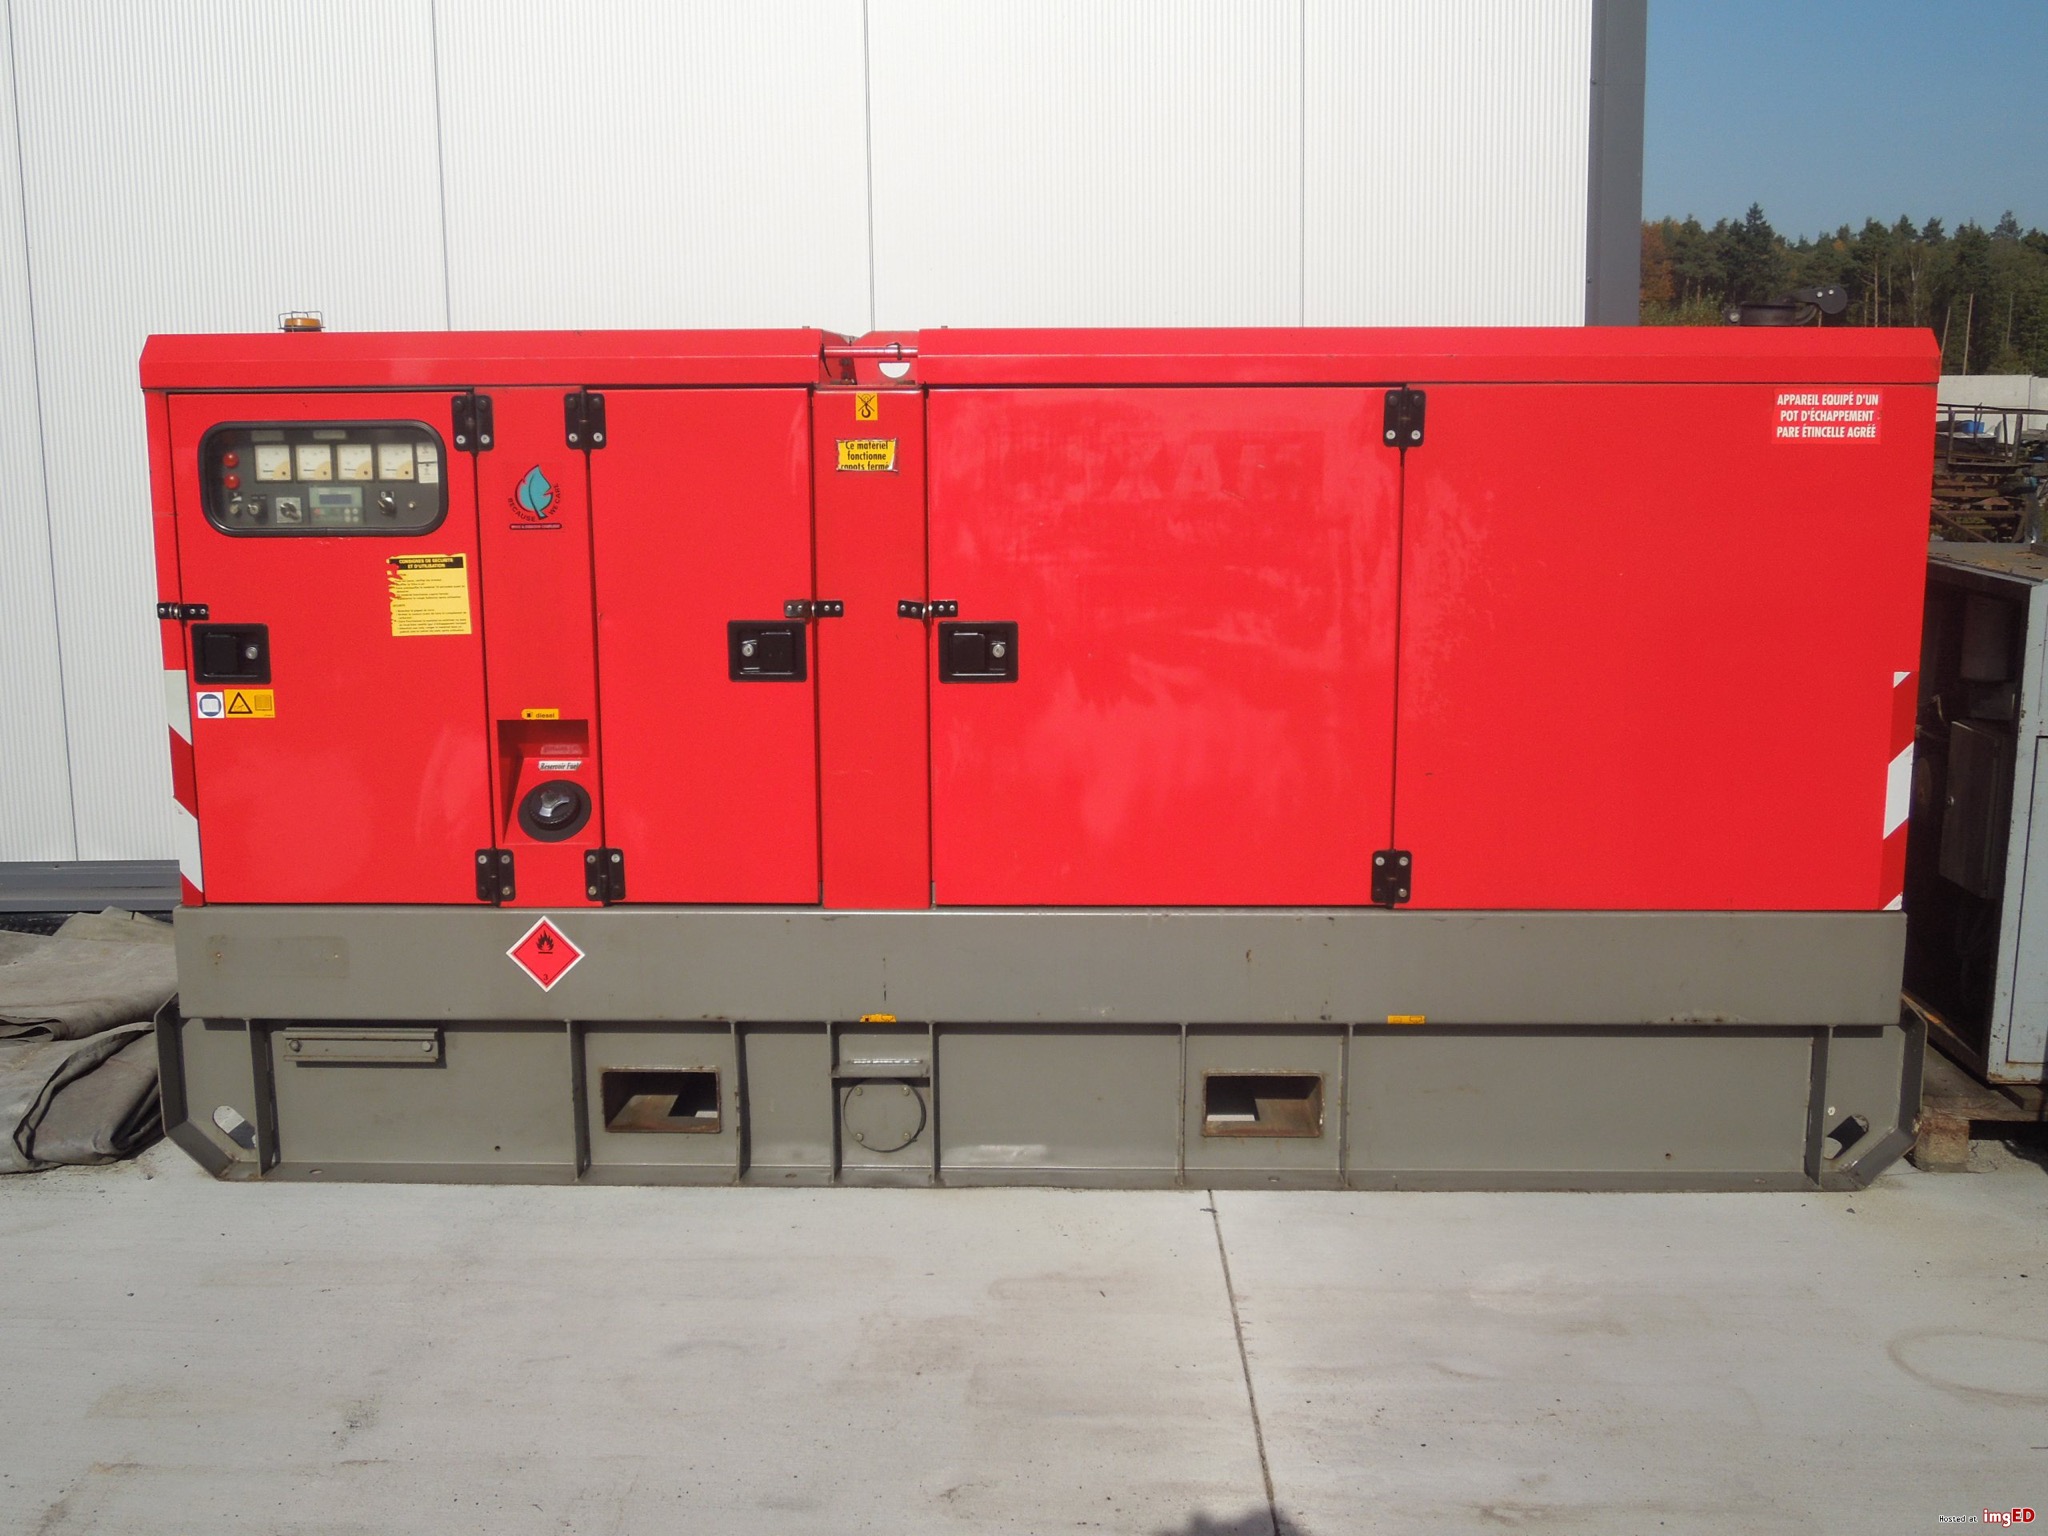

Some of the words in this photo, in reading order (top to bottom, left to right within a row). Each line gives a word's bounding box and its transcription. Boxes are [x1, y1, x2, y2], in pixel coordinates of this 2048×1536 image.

[1777, 394, 1820, 406] APPAREIL
[1821, 391, 1854, 406] EQUIPÉ
[1856, 394, 1879, 406] D'UN
[1780, 410, 1799, 422] POT
[1801, 407, 1875, 422] D'ÉCHAPPEMENT
[1776, 426, 1800, 438] PARE
[1802, 423, 1845, 438] ÉTINCELLE
[1847, 423, 1877, 438] AGRÉÉ
[845, 441, 855, 450] Ce
[847, 450, 886, 461] fonctionne
[867, 460, 891, 470] fermé
[507, 497, 536, 522] BECAUSE
[543, 973, 549, 981] 3
